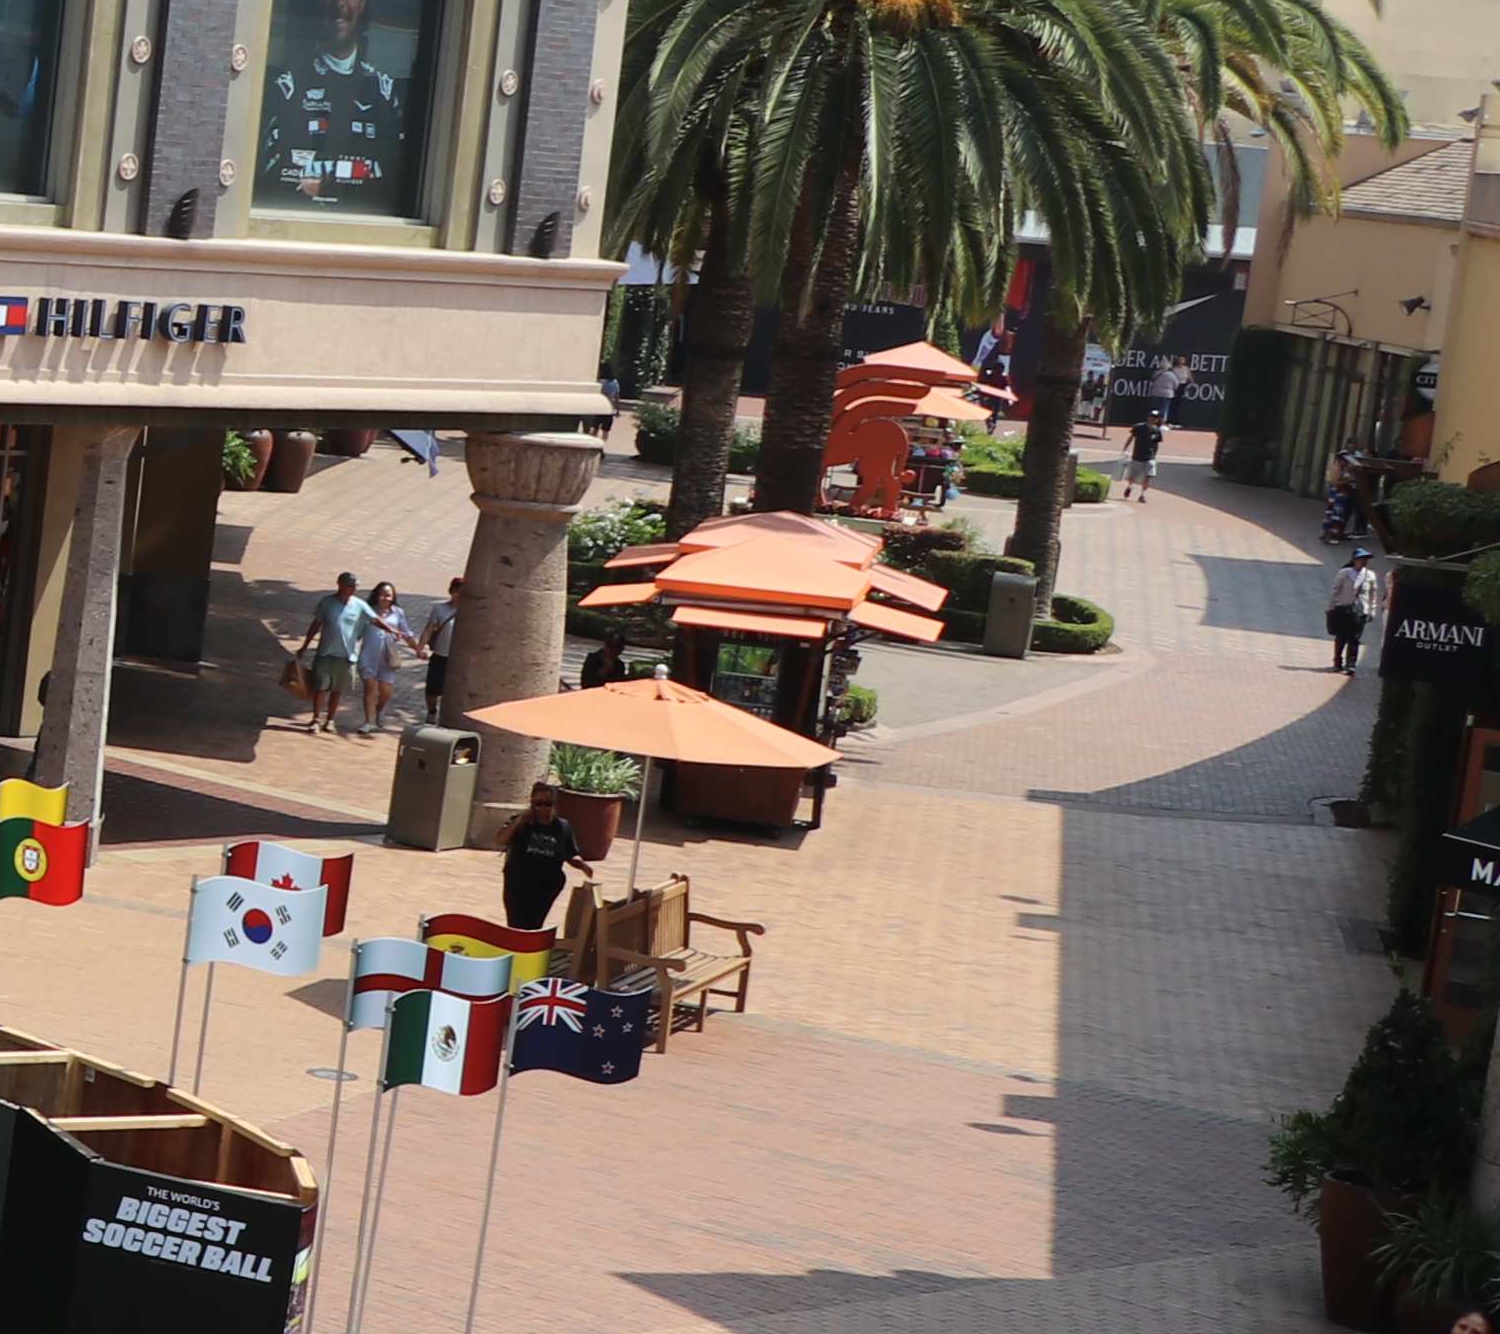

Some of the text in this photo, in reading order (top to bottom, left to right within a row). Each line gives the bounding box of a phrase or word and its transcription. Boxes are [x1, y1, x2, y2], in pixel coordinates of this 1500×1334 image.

[35, 296, 247, 344] HILFIGER
[1393, 618, 1485, 647] ARMANI
[1415, 641, 1459, 653] OUTLET
[146, 1185, 221, 1212] THE WORLD'S
[115, 1195, 248, 1246] BIGGEST
[82, 1217, 273, 1284] SOCCER BALL
